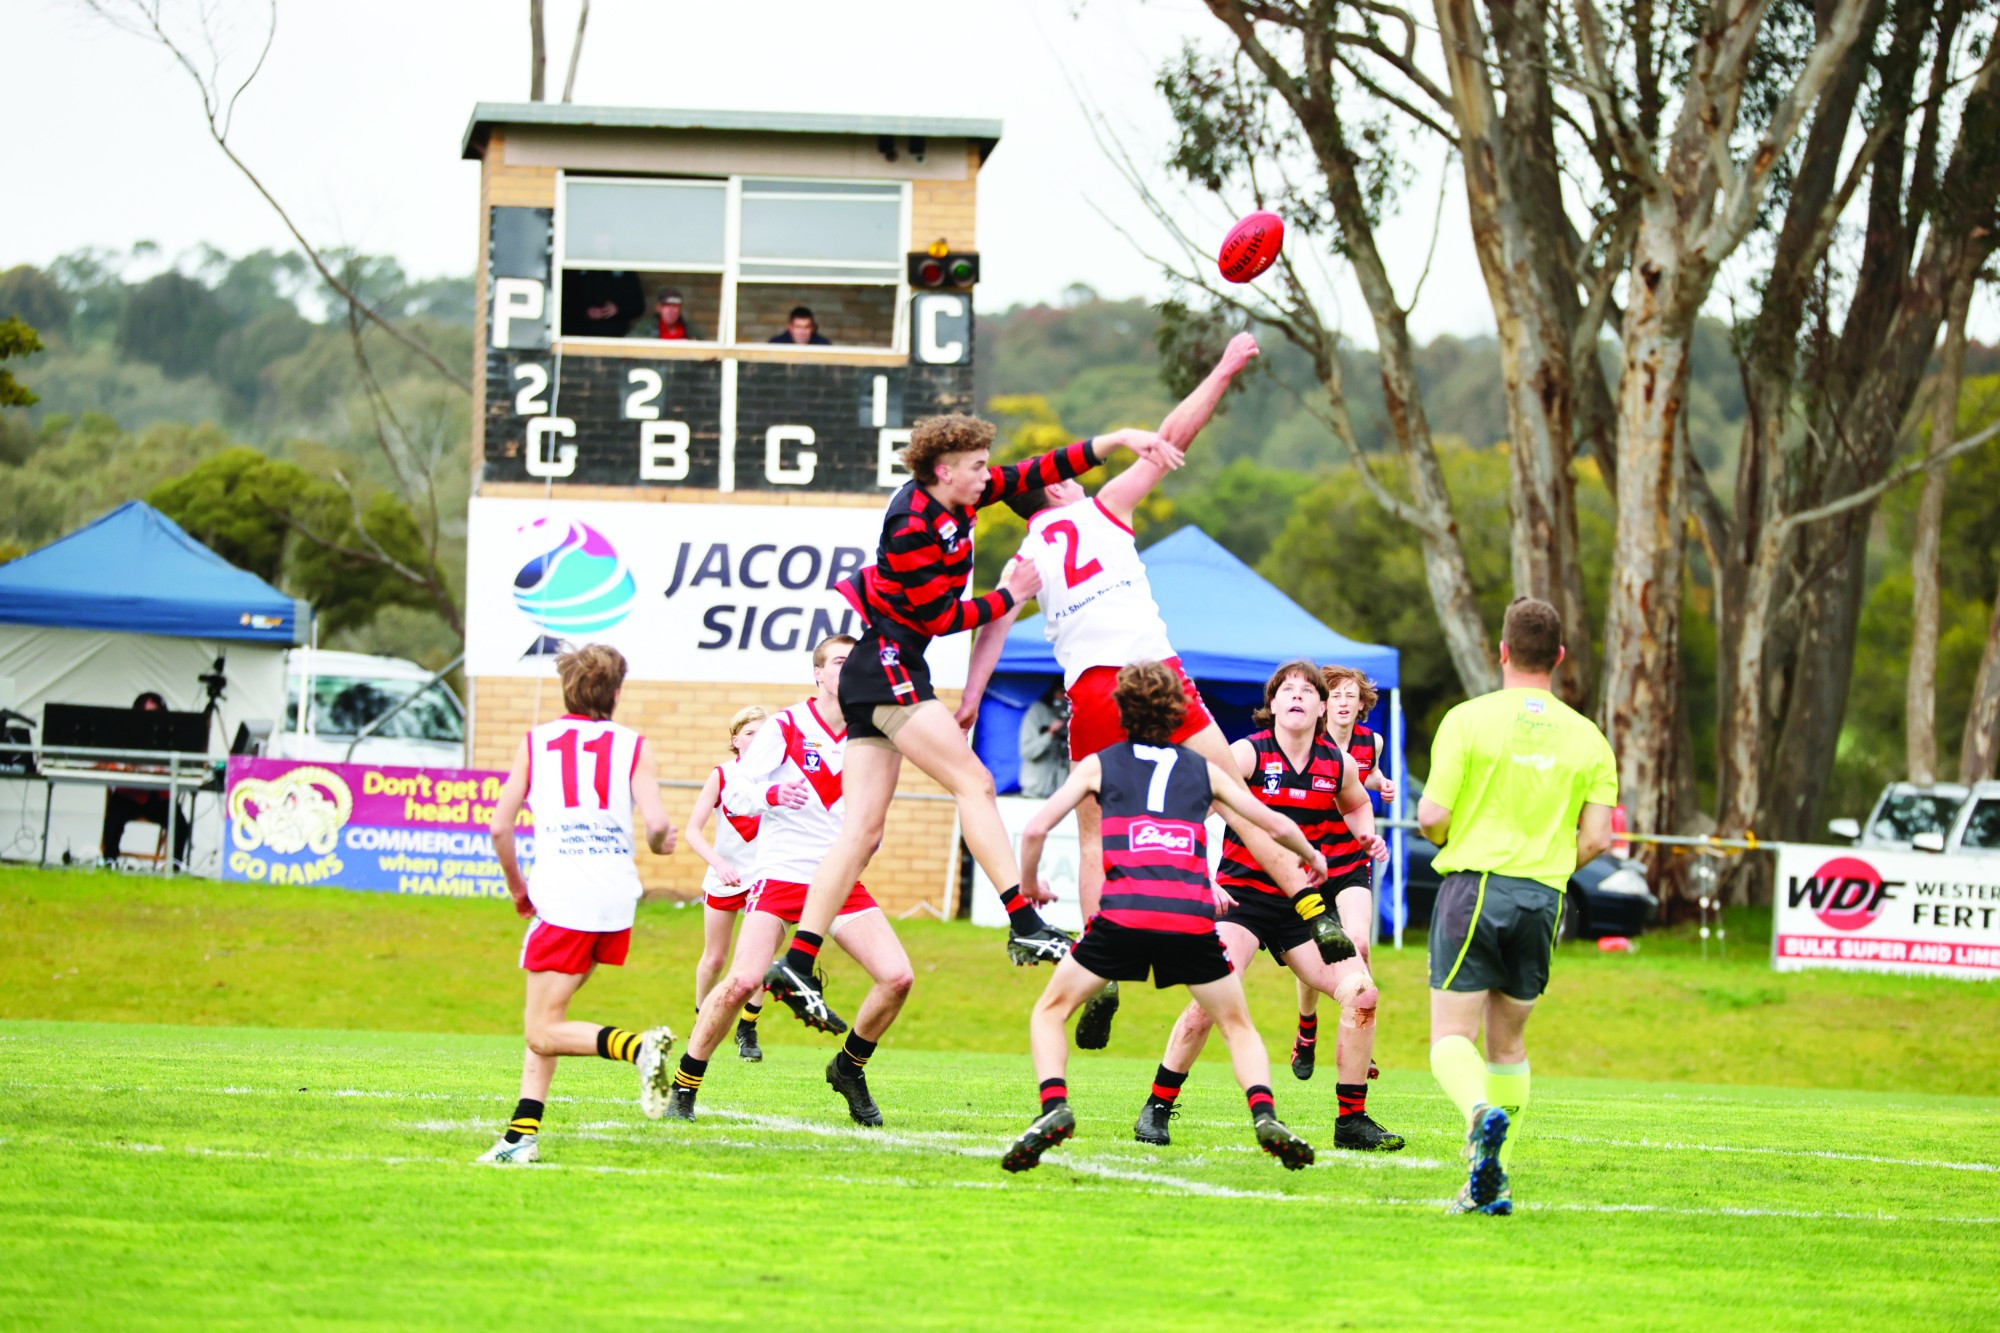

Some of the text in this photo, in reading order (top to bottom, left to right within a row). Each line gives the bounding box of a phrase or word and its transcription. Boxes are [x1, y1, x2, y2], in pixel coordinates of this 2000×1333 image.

[1223, 226, 1266, 277] SHERRIN
[492, 277, 544, 347] P
[918, 296, 962, 364] C
[515, 363, 548, 415] 2
[625, 368, 662, 420] 2
[526, 416, 577, 477] G
[640, 420, 690, 480] B
[765, 424, 817, 484] G
[664, 542, 866, 598] JACOB
[1041, 519, 1103, 589] 2
[697, 605, 868, 651] SIGN
[363, 771, 432, 797] Don't
[435, 779, 478, 804] get
[547, 728, 614, 810] 11
[1133, 743, 1178, 813] 7
[404, 798, 469, 823] head
[345, 826, 501, 856] COMMERCIAL
[1134, 825, 1190, 849] Elders
[229, 851, 344, 886] GO RAMS
[378, 852, 438, 874] when
[441, 855, 508, 878] grazin
[400, 874, 513, 898] HAMILTO
[1788, 876, 1907, 912] WDF
[1913, 903, 2000, 929] FERT
[1784, 937, 1837, 957] BULK
[1839, 940, 1907, 960] SUPER
[1909, 944, 1952, 964] AND
